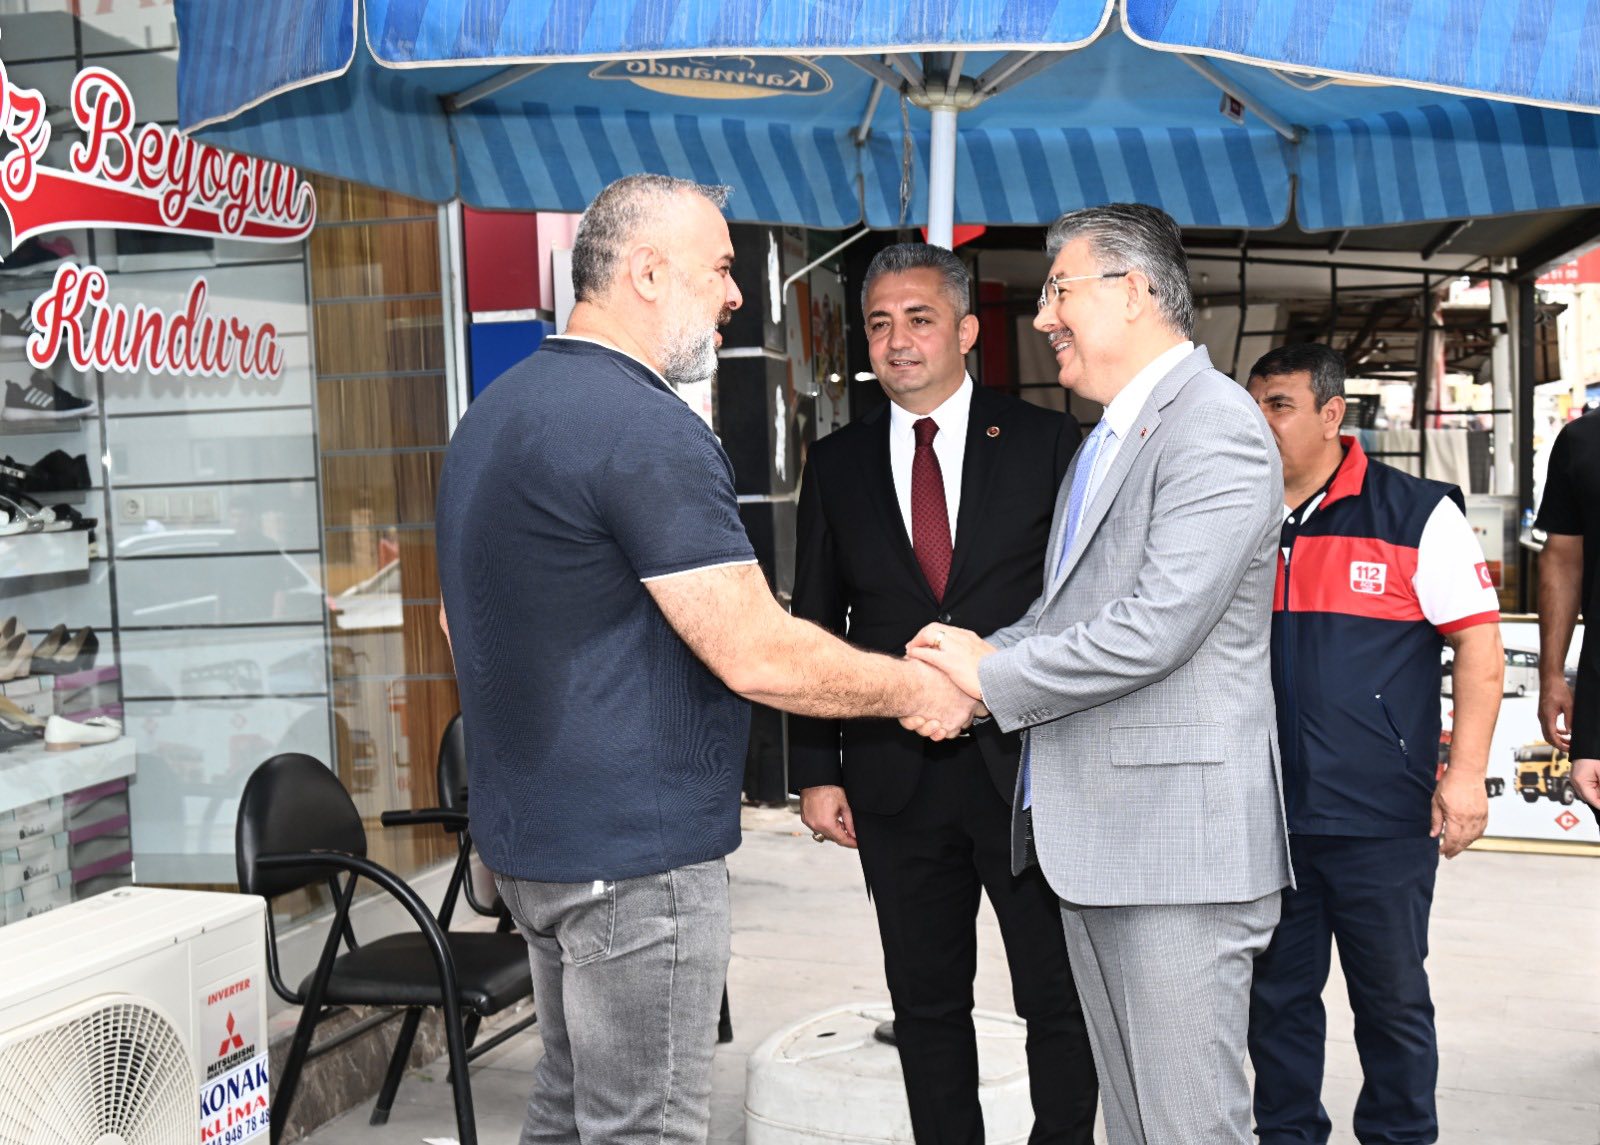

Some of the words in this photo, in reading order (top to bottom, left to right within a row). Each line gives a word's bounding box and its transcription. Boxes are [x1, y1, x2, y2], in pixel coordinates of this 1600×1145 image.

[0, 57, 51, 200] z
[27, 263, 284, 380] Kundura
[1356, 566, 1380, 580] 112
[208, 978, 250, 1006] INVERTER
[207, 1043, 255, 1074] MITSUBISHI
[200, 1059, 268, 1120] KONAK
[201, 1095, 267, 1143] KLİMA
[225, 1124, 242, 1145] 948
[245, 1116, 257, 1134] 78
[260, 1108, 270, 1125] 48
